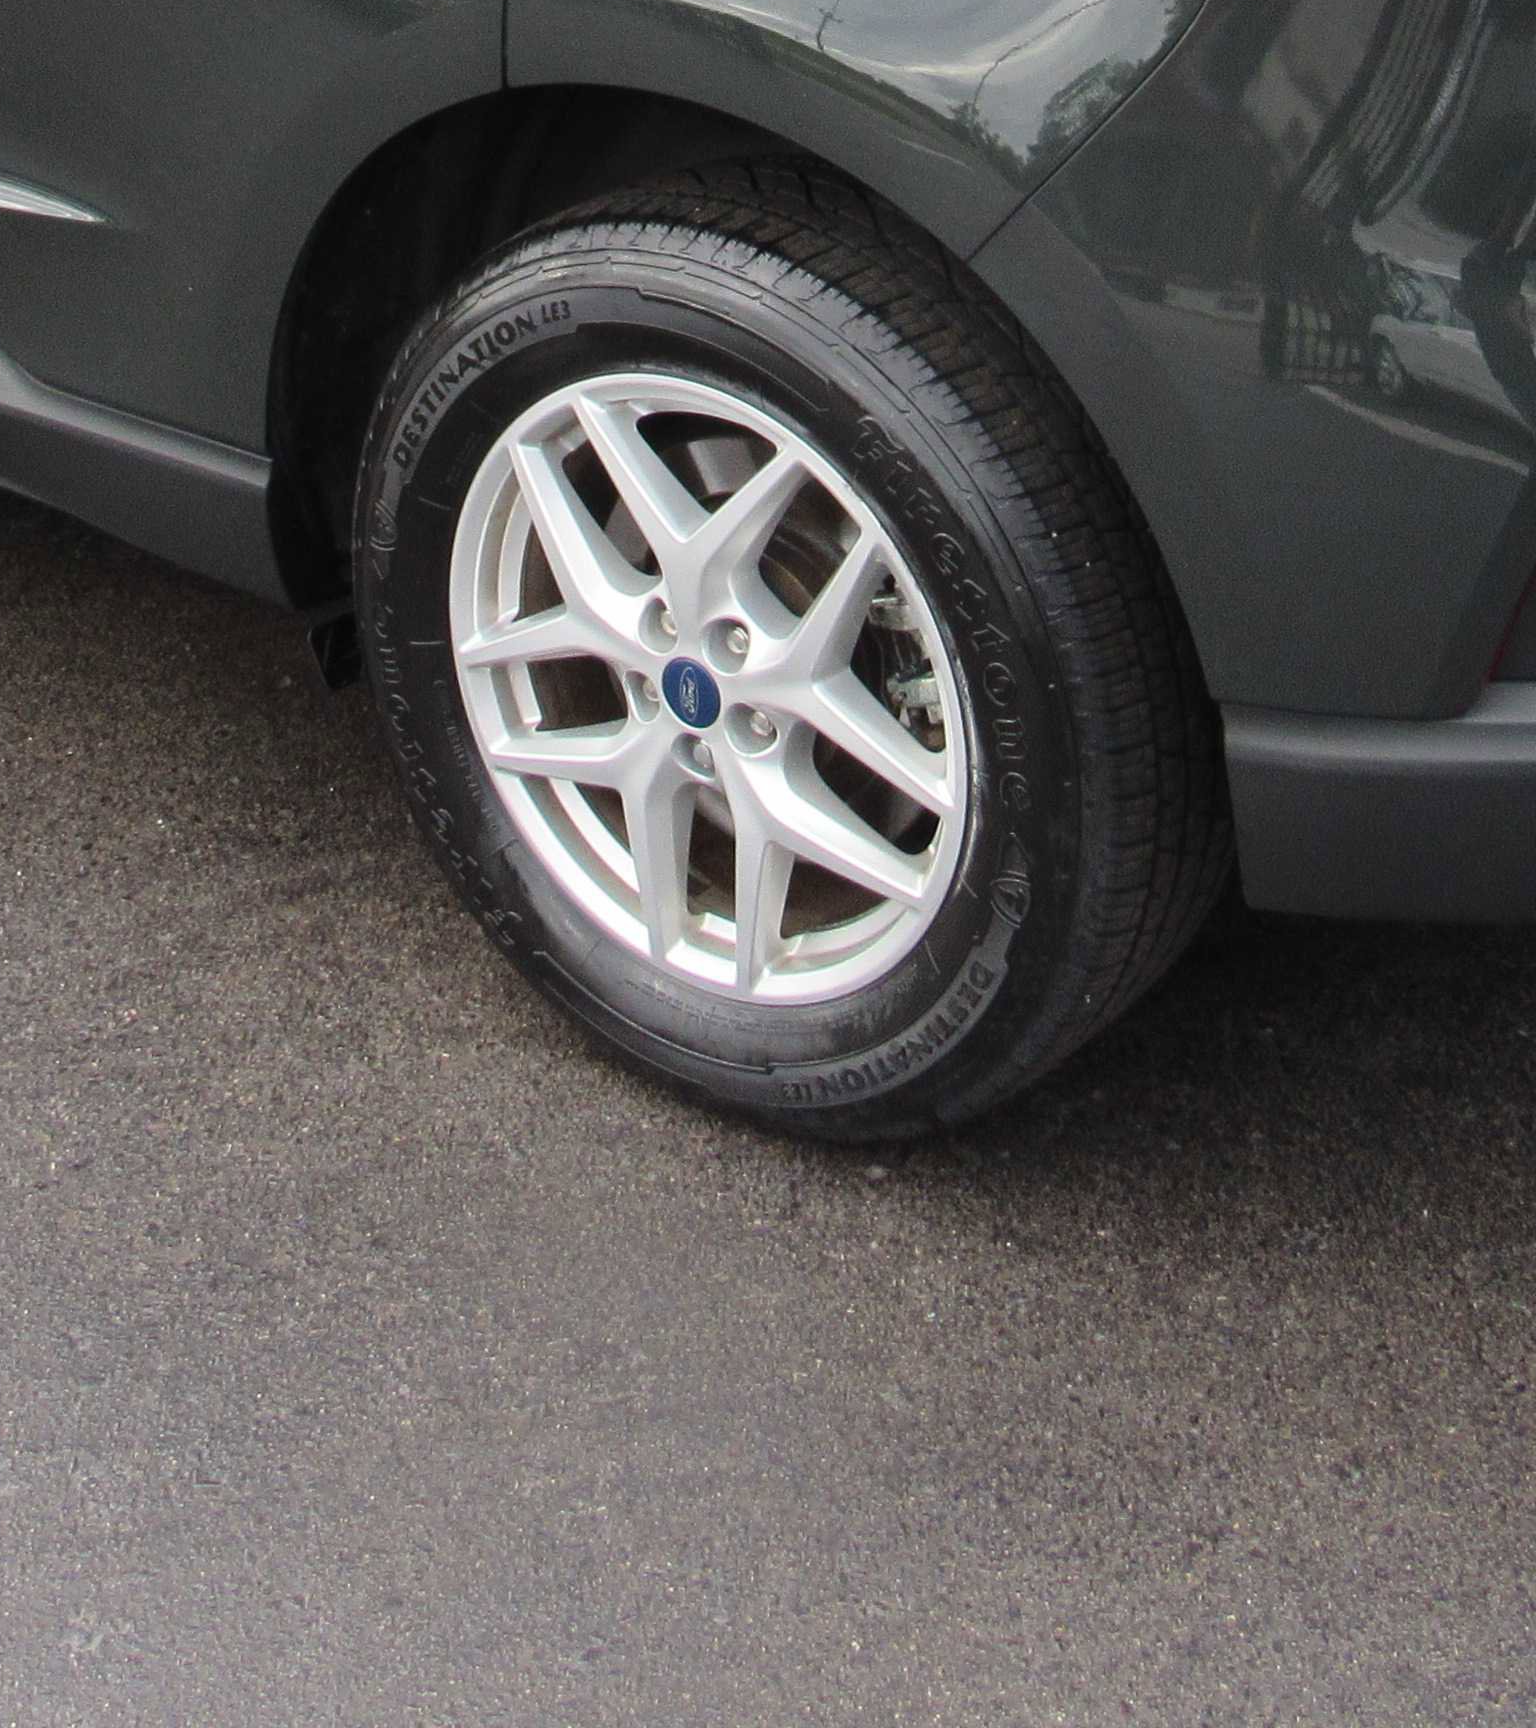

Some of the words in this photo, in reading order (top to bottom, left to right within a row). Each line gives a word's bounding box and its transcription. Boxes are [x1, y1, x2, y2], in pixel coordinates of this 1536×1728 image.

[391, 310, 537, 470] DESTINATION
[541, 299, 572, 323] LE3
[816, 959, 995, 1100] DESTINATION
